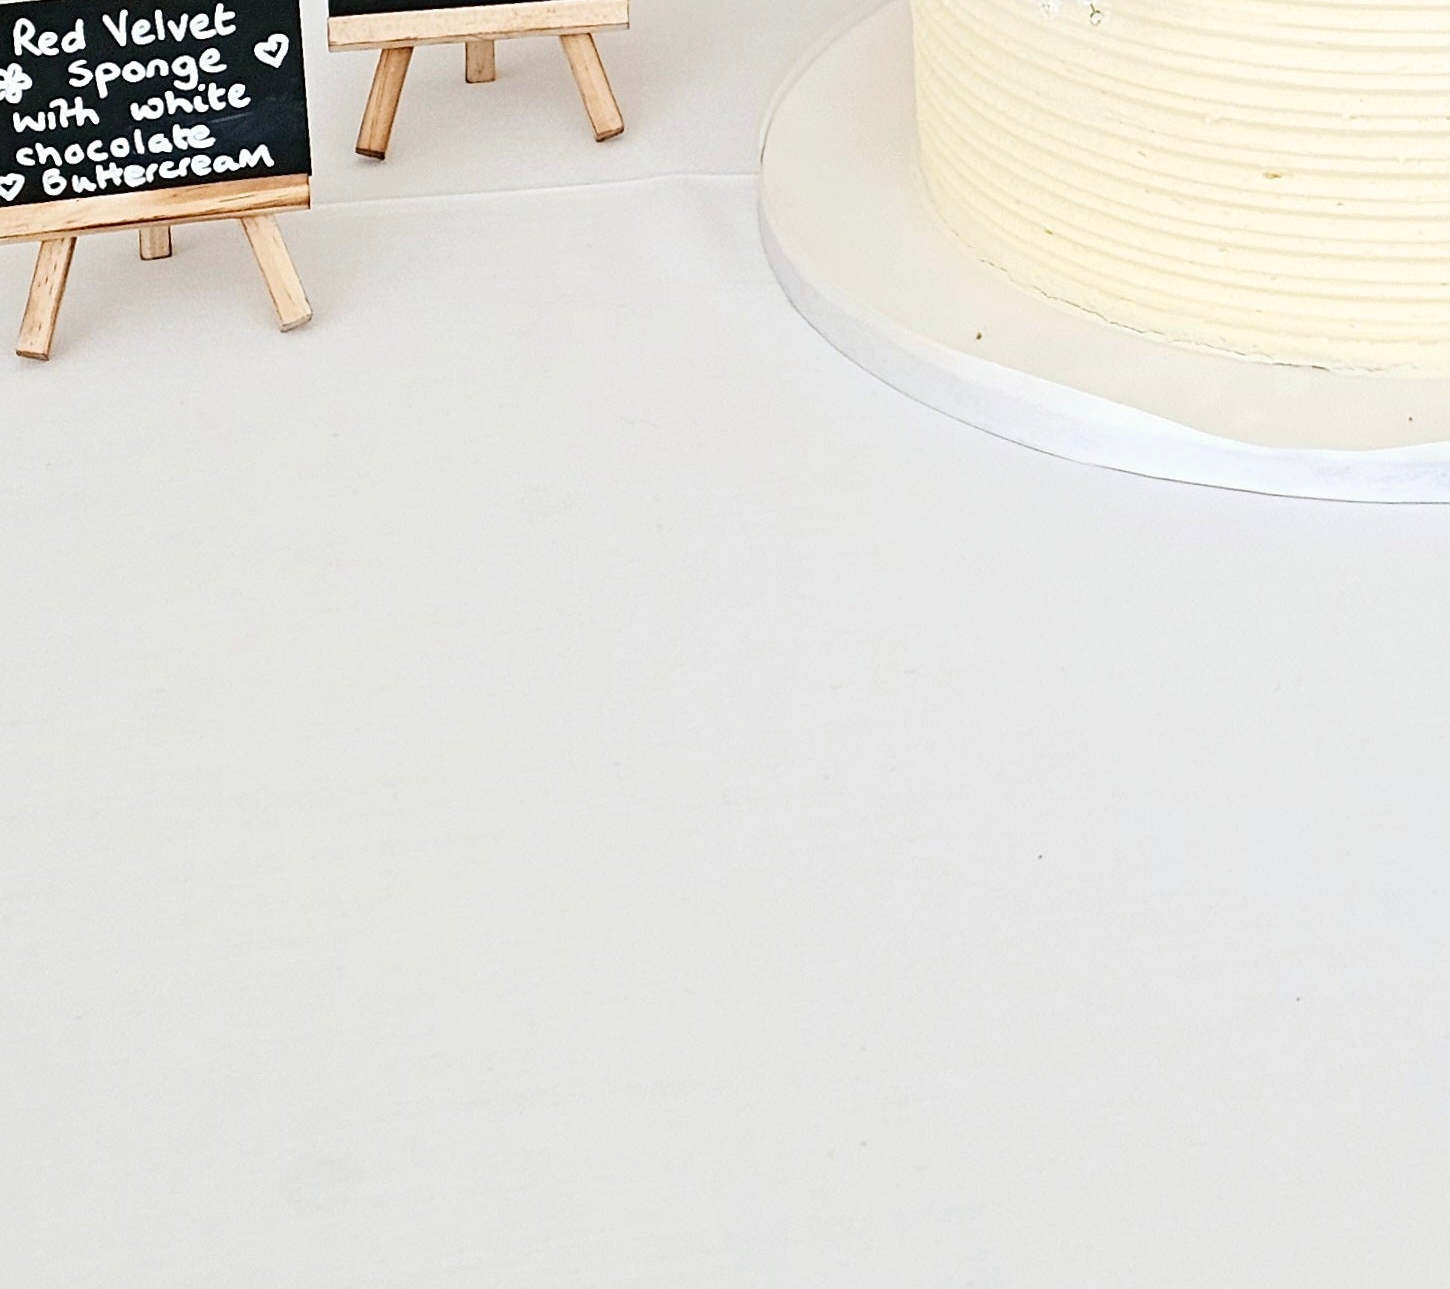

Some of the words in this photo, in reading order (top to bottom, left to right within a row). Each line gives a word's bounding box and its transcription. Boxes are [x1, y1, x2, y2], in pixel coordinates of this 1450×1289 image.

[13, 18, 86, 56] Red
[103, 3, 236, 46] Velvet
[13, 97, 100, 132] with
[130, 83, 251, 121] white
